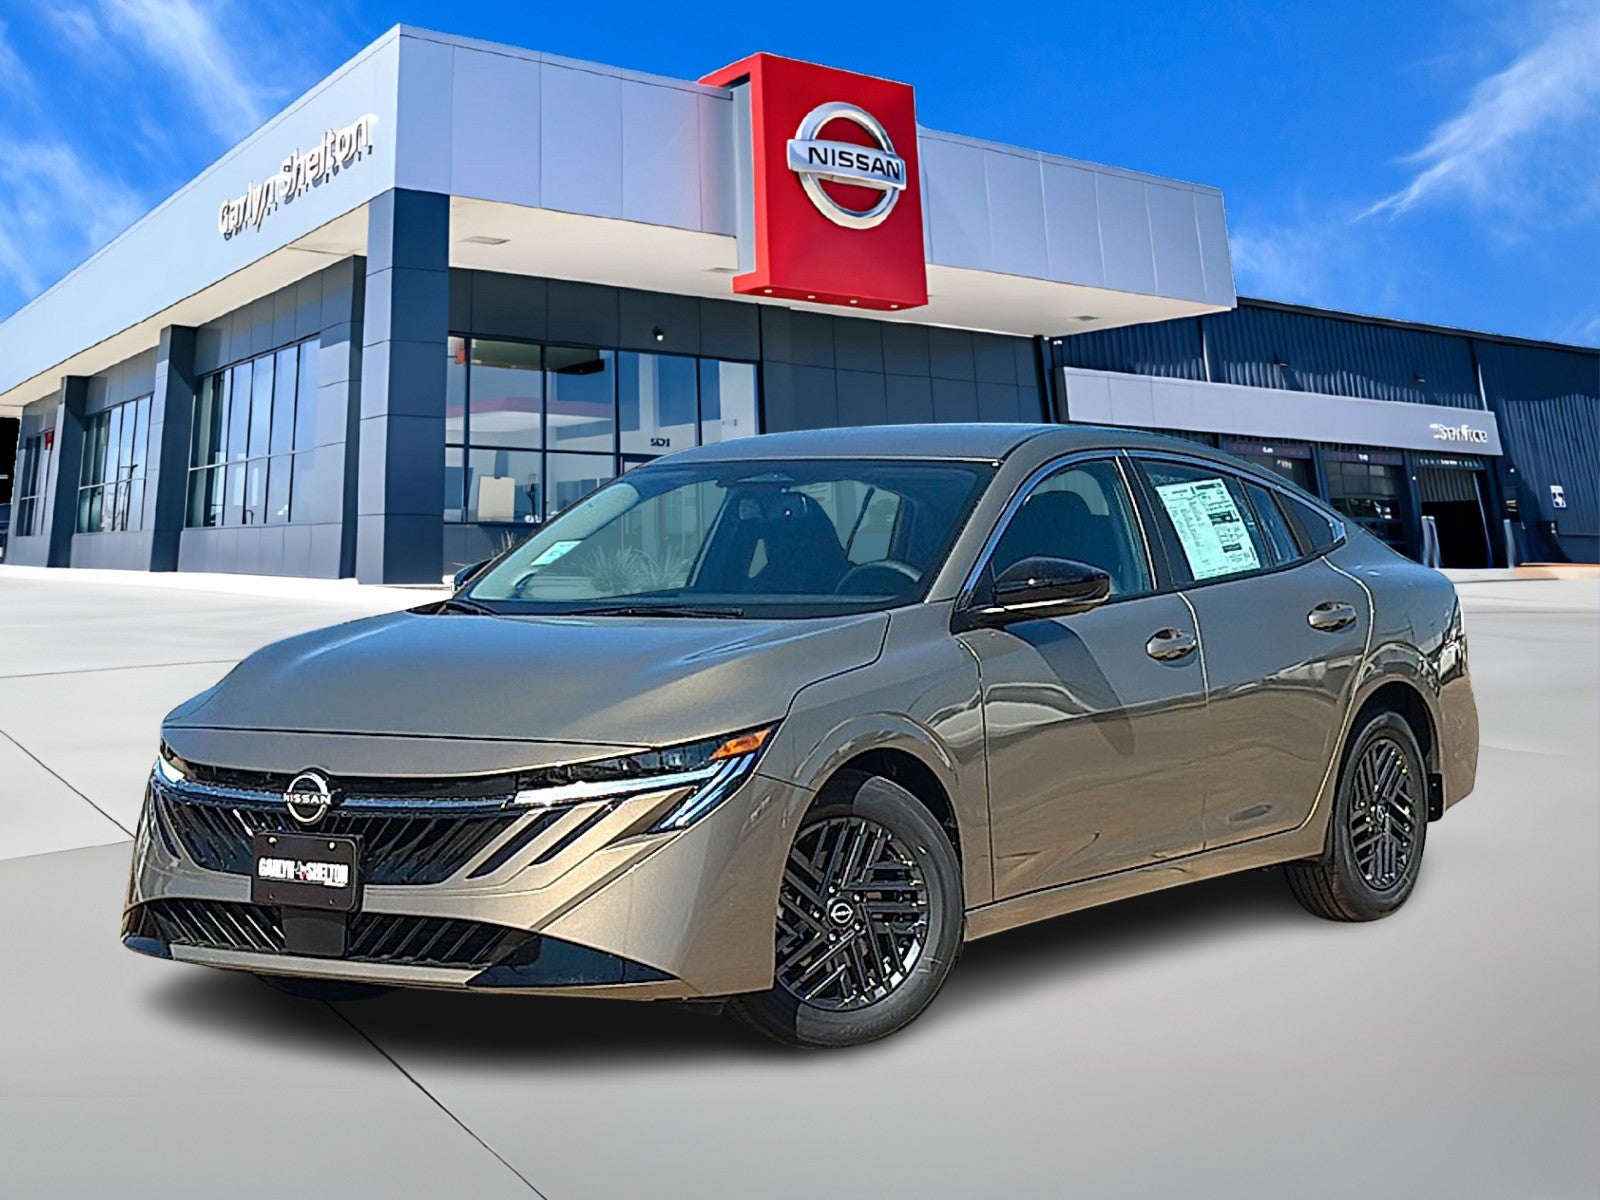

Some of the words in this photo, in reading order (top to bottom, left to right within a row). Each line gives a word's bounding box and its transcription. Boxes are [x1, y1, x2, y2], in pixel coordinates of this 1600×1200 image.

[279, 115, 374, 200] Shelton
[808, 147, 900, 180] NISSAN
[283, 792, 332, 805] NISSAN
